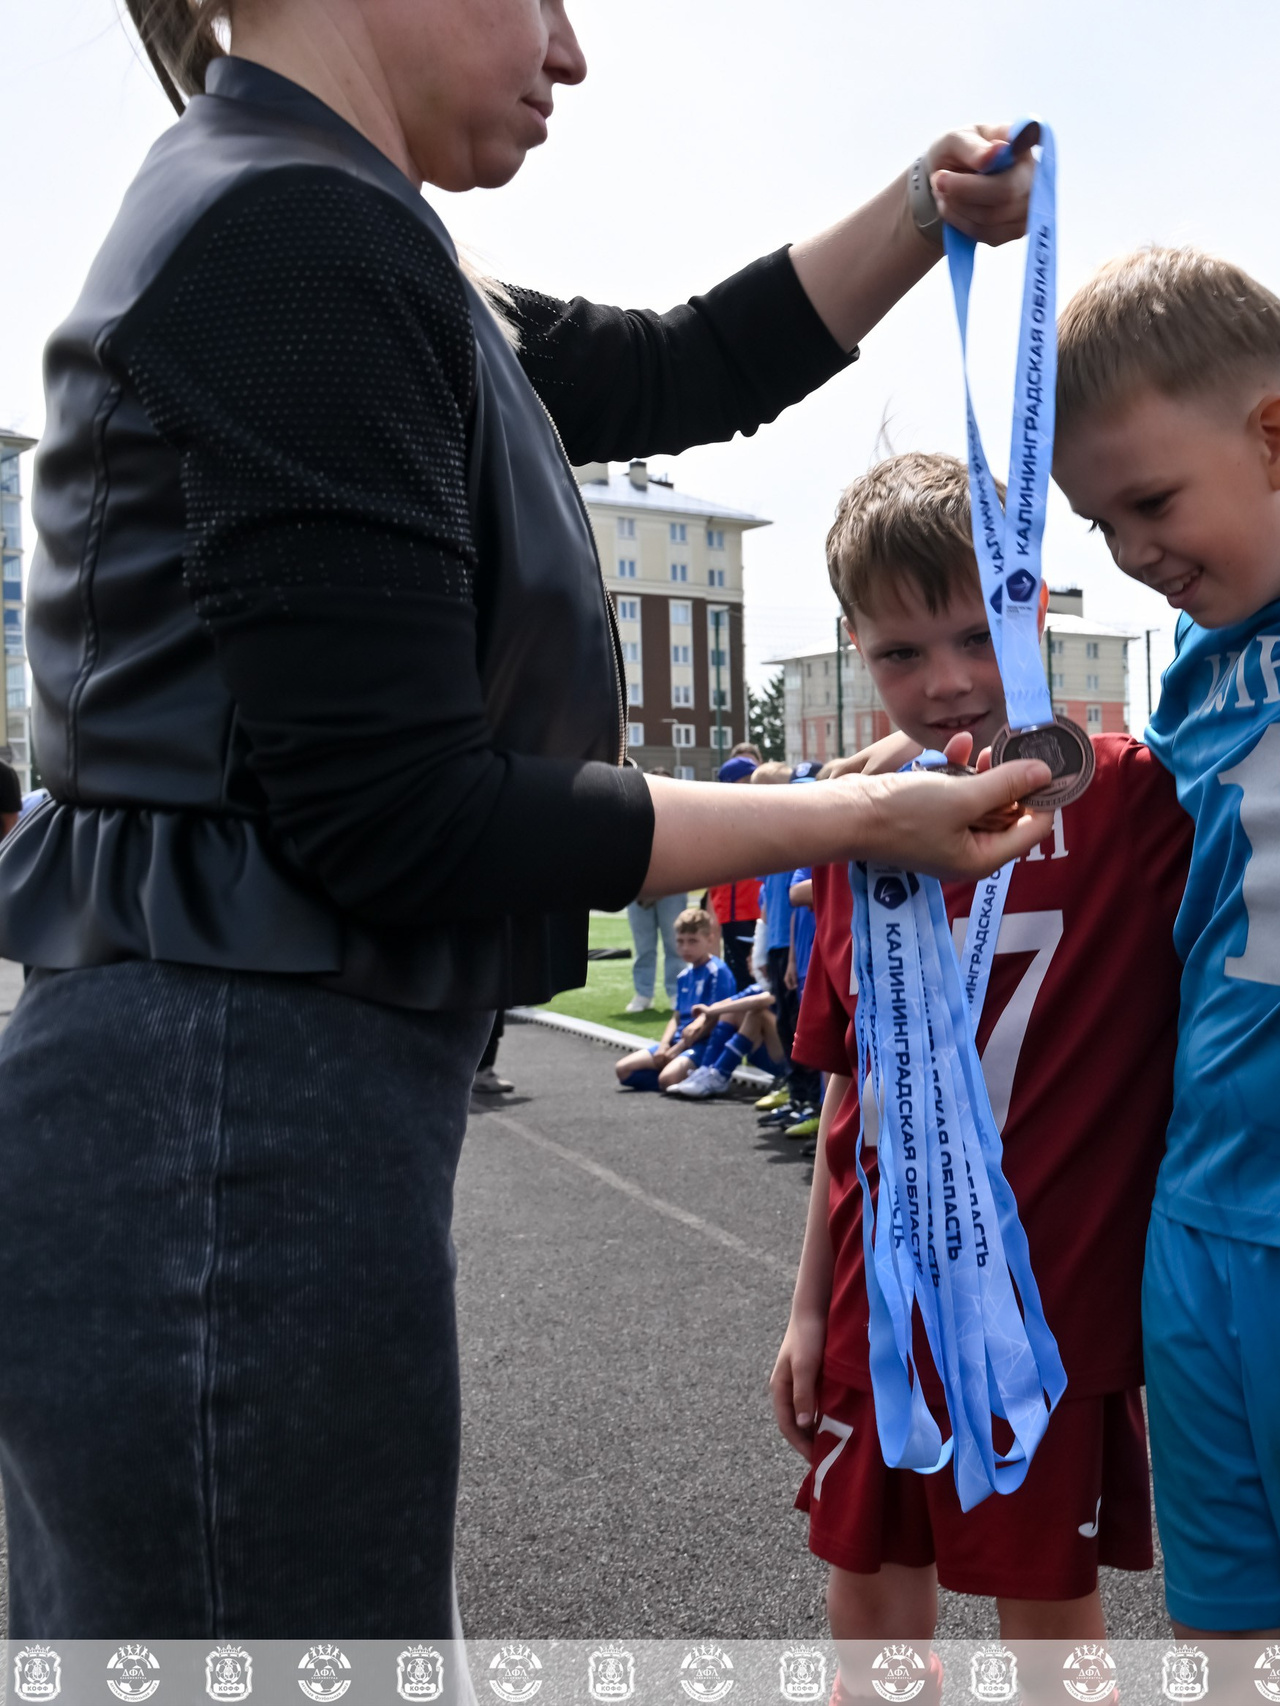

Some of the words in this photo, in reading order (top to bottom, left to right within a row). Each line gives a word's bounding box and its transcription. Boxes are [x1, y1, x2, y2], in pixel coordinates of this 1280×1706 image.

[1016, 328, 1043, 556] КАЛИНИНГРАДСКАЯ
[1031, 225, 1051, 324] ОБЛАСТЬ
[885, 923, 917, 1160] КАЛИНИНГРАДСКАЯ
[905, 1166, 924, 1275] ОБЛАСТЬ
